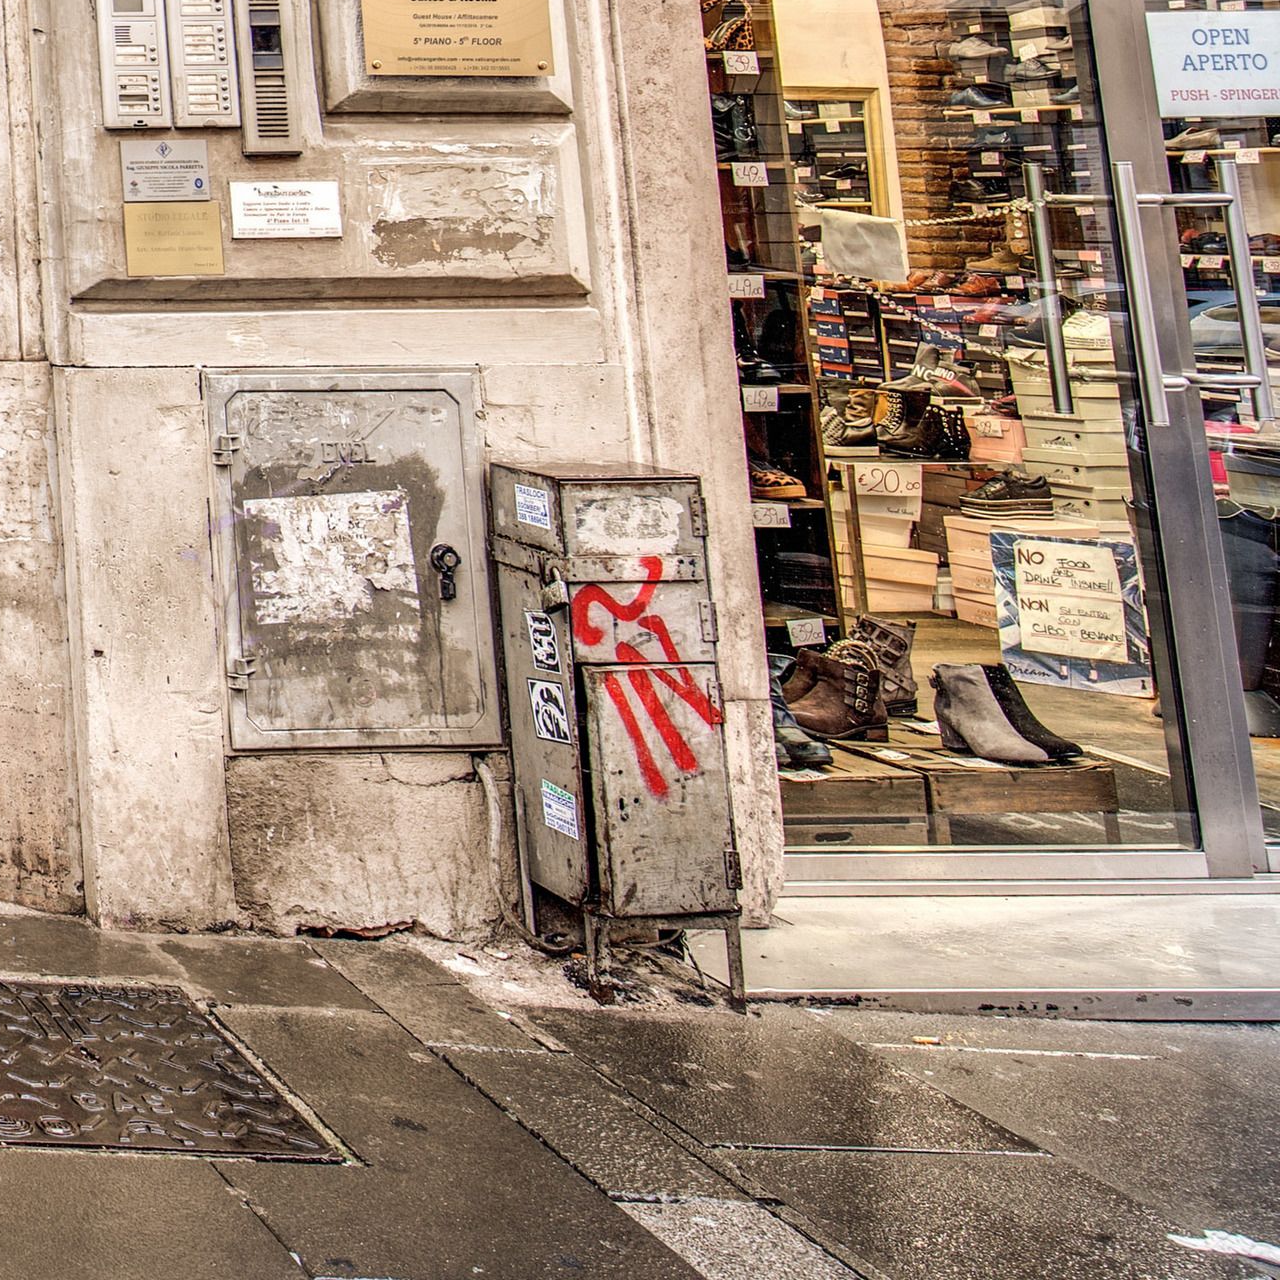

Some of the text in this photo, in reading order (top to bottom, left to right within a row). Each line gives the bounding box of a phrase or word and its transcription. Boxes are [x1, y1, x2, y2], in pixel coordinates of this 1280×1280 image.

[424, 37, 451, 45] PIANO
[471, 37, 502, 46] FLOOR
[1192, 28, 1250, 46] OPEN
[1181, 53, 1268, 71] APERTO
[1171, 89, 1209, 101] PUSH
[1220, 88, 1280, 101] SPINGER
[321, 442, 376, 464] ENEL
[516, 486, 546, 499] TRASLOCHI
[1017, 548, 1091, 569] NO FOOD
[1023, 570, 1062, 585] DRINK
[1052, 568, 1074, 577] AND
[1020, 597, 1049, 613] NON
[1058, 616, 1081, 625] CON
[1059, 606, 1111, 620] SI ENTRA
[1032, 623, 1066, 636] CIBO
[1007, 663, 1053, 678] Dream
[543, 780, 574, 801] TRASLOCHI
[71, 1091, 174, 1115] GAS
